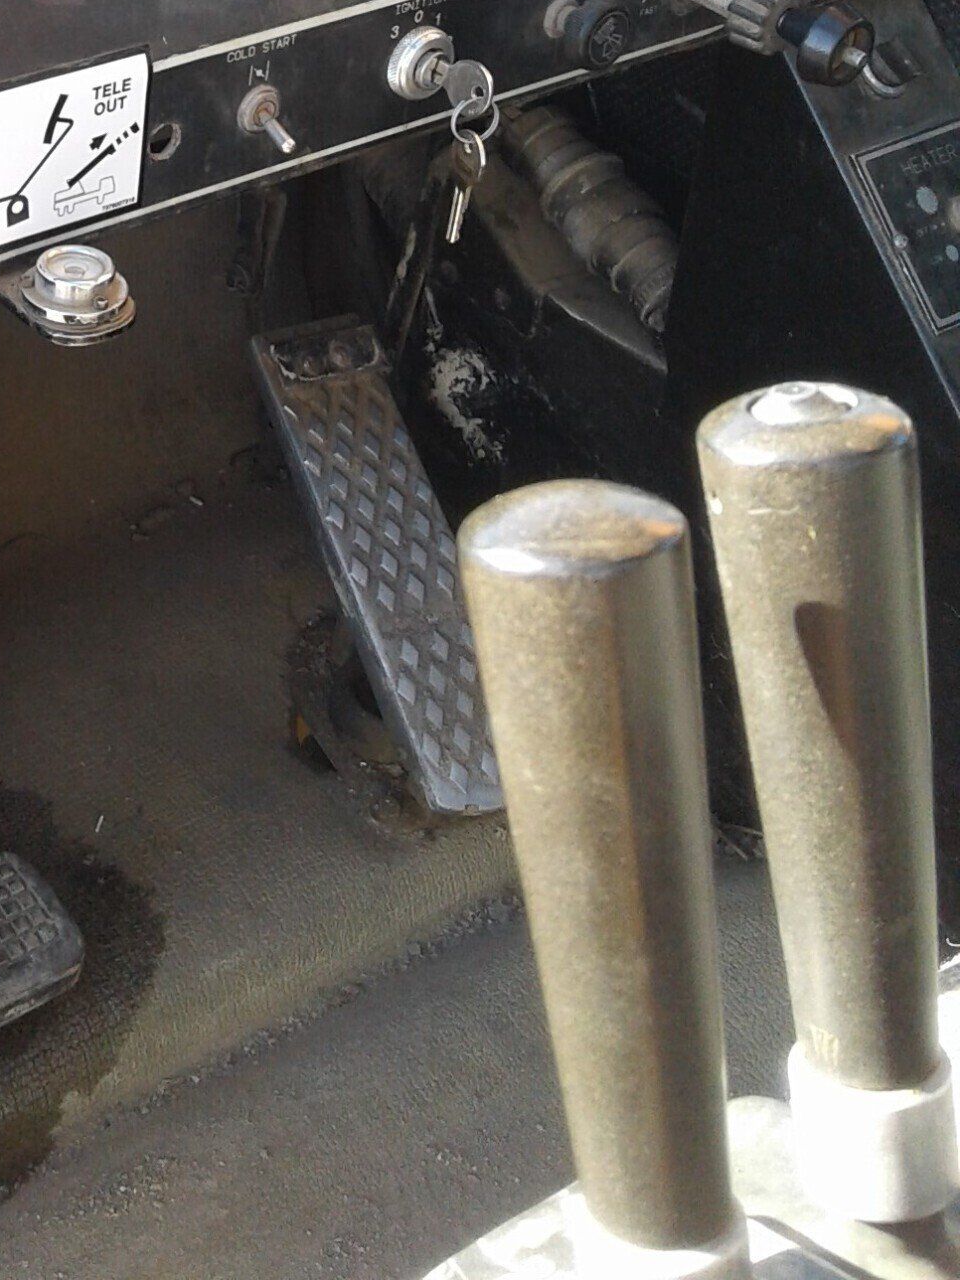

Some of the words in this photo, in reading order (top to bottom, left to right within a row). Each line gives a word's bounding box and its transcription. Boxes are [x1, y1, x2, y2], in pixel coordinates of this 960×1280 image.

[414, 10, 424, 23] 0
[435, 13, 441, 26] 1
[390, 25, 400, 39] 3
[227, 47, 256, 63] COLD
[262, 33, 297, 53] START
[93, 78, 132, 100] TELE
[94, 96, 126, 116] OUT
